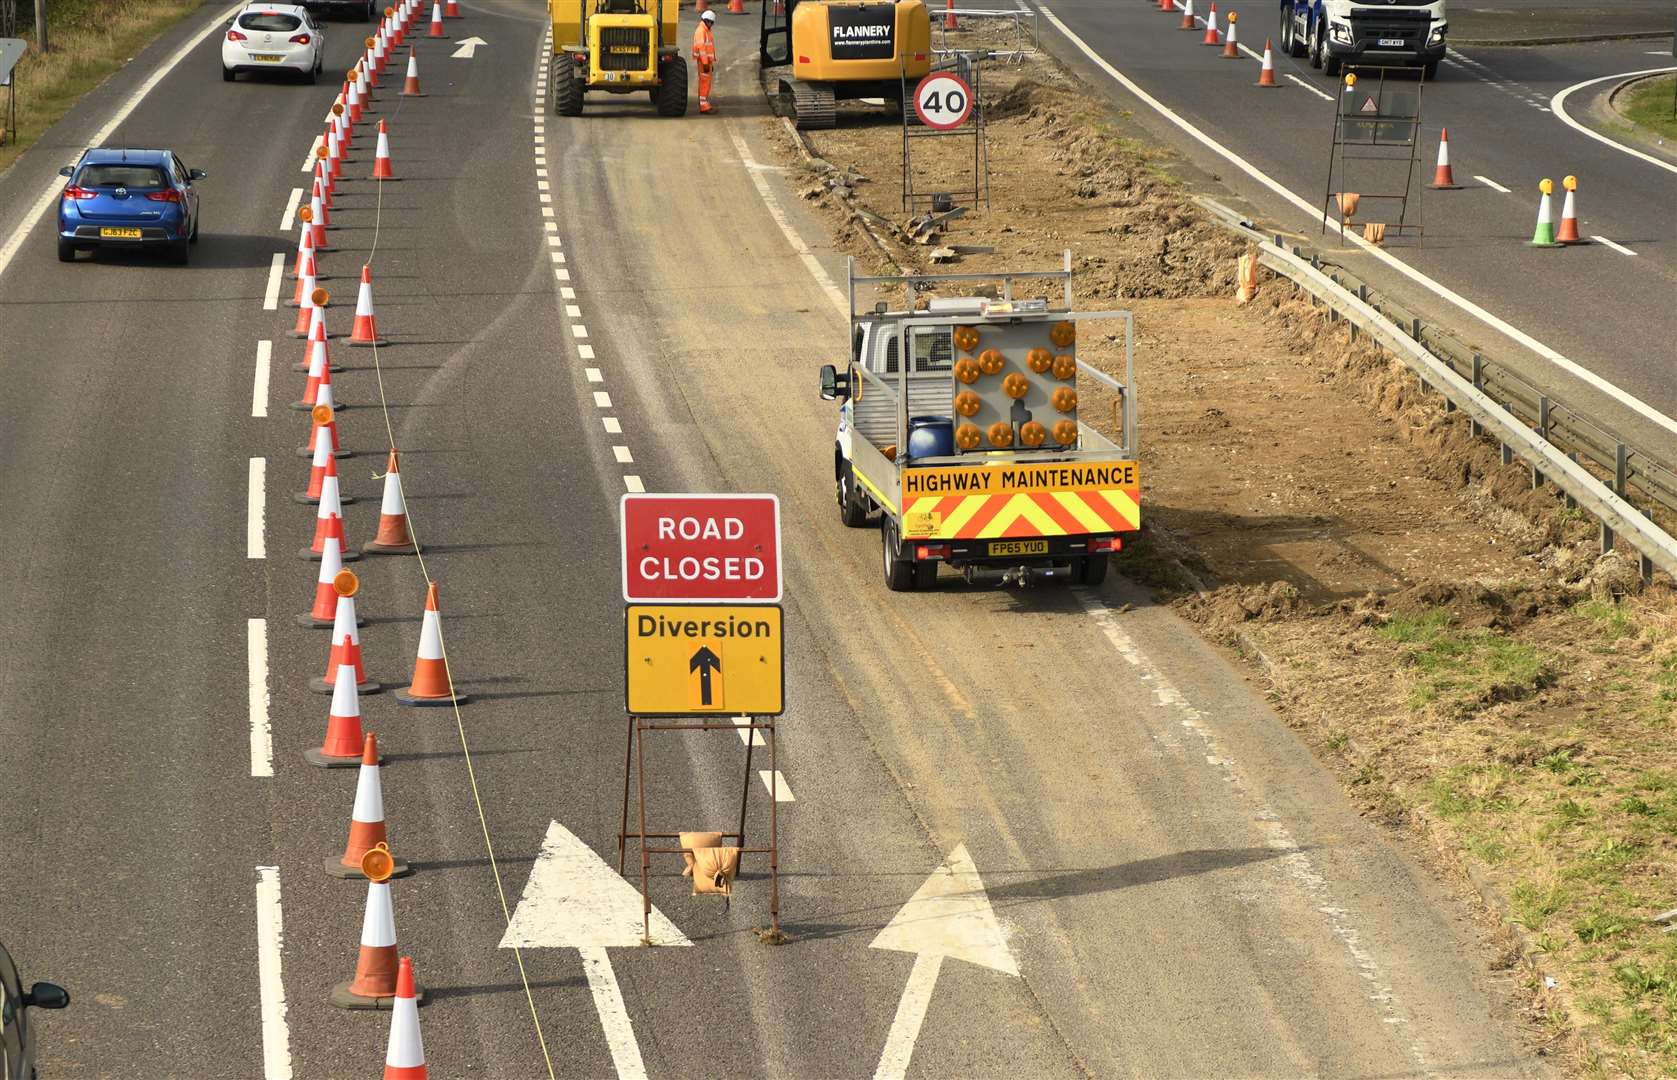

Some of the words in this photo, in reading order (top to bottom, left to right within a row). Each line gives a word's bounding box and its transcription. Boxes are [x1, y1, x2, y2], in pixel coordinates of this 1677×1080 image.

[833, 25, 891, 38] FLANNERY
[922, 91, 965, 114] 40
[906, 471, 992, 493] HIGHWAY
[1002, 466, 1135, 488] MAINTENANCE
[657, 517, 745, 540] ROAD
[993, 543, 1021, 554] FP65
[639, 556, 765, 581] CLOSED
[637, 614, 771, 638] Diversion
